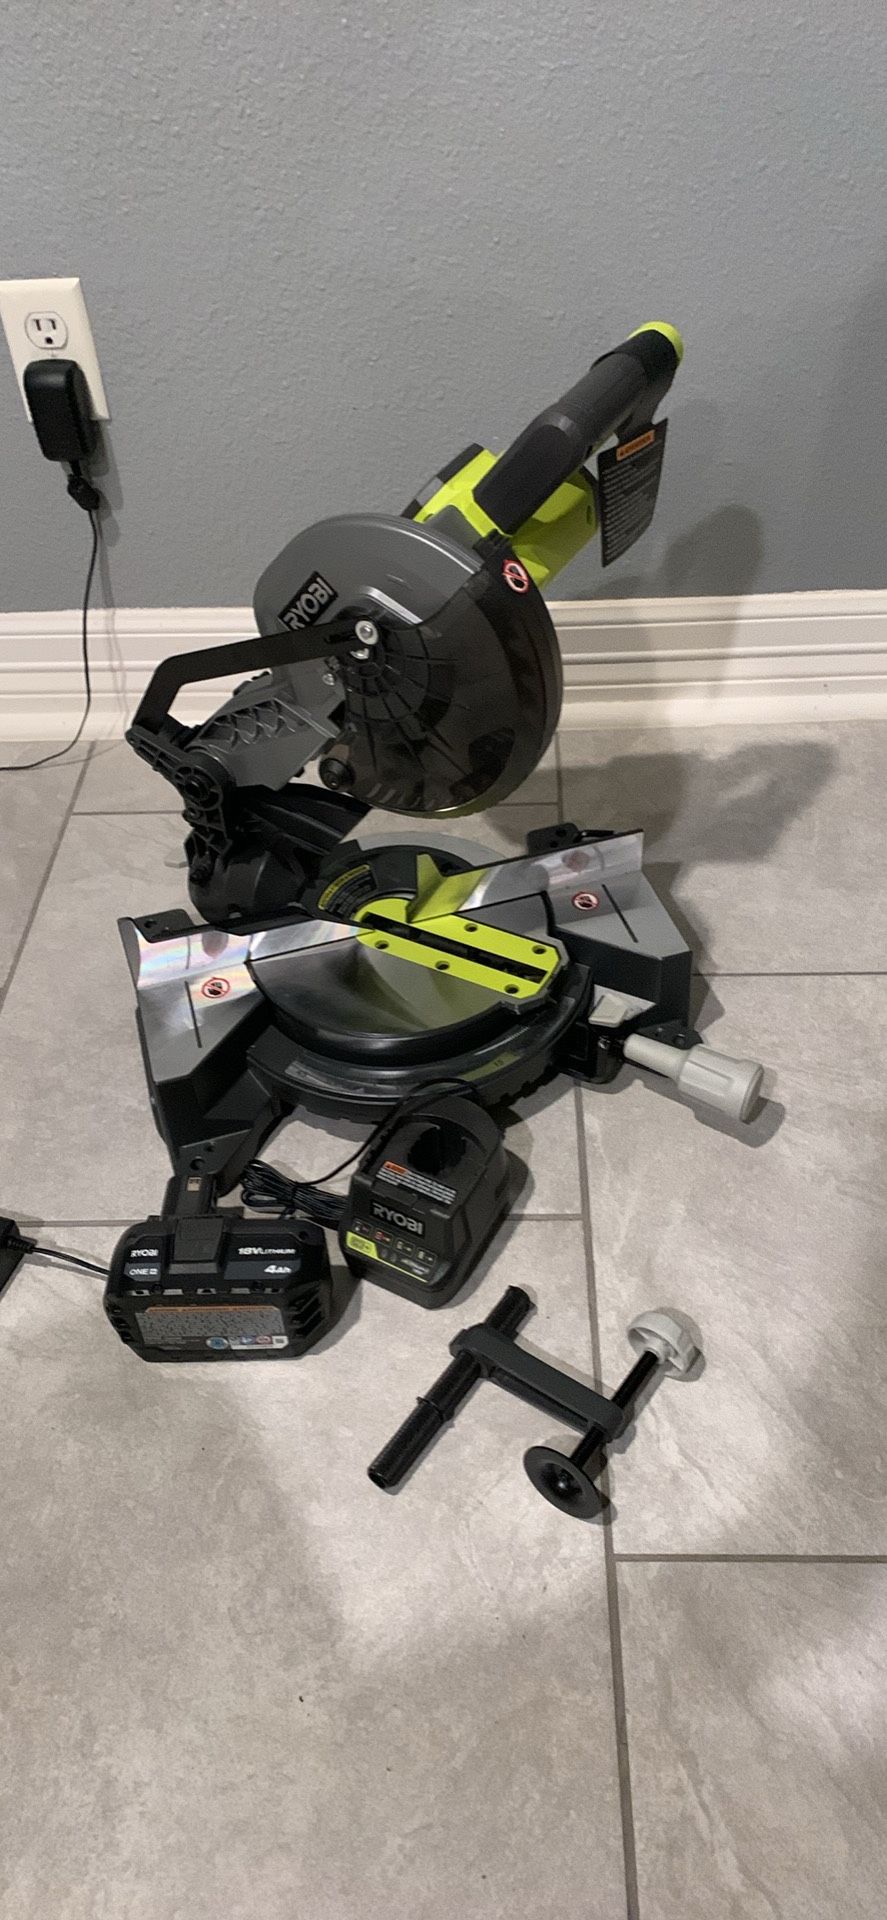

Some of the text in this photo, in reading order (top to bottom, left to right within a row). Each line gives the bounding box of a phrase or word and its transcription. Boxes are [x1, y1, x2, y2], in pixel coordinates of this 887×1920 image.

[283, 577, 334, 630] RYOBI
[372, 1202, 424, 1235] RYOBI
[130, 1248, 159, 1257] RYOBI
[264, 1264, 293, 1274] 4Ah
